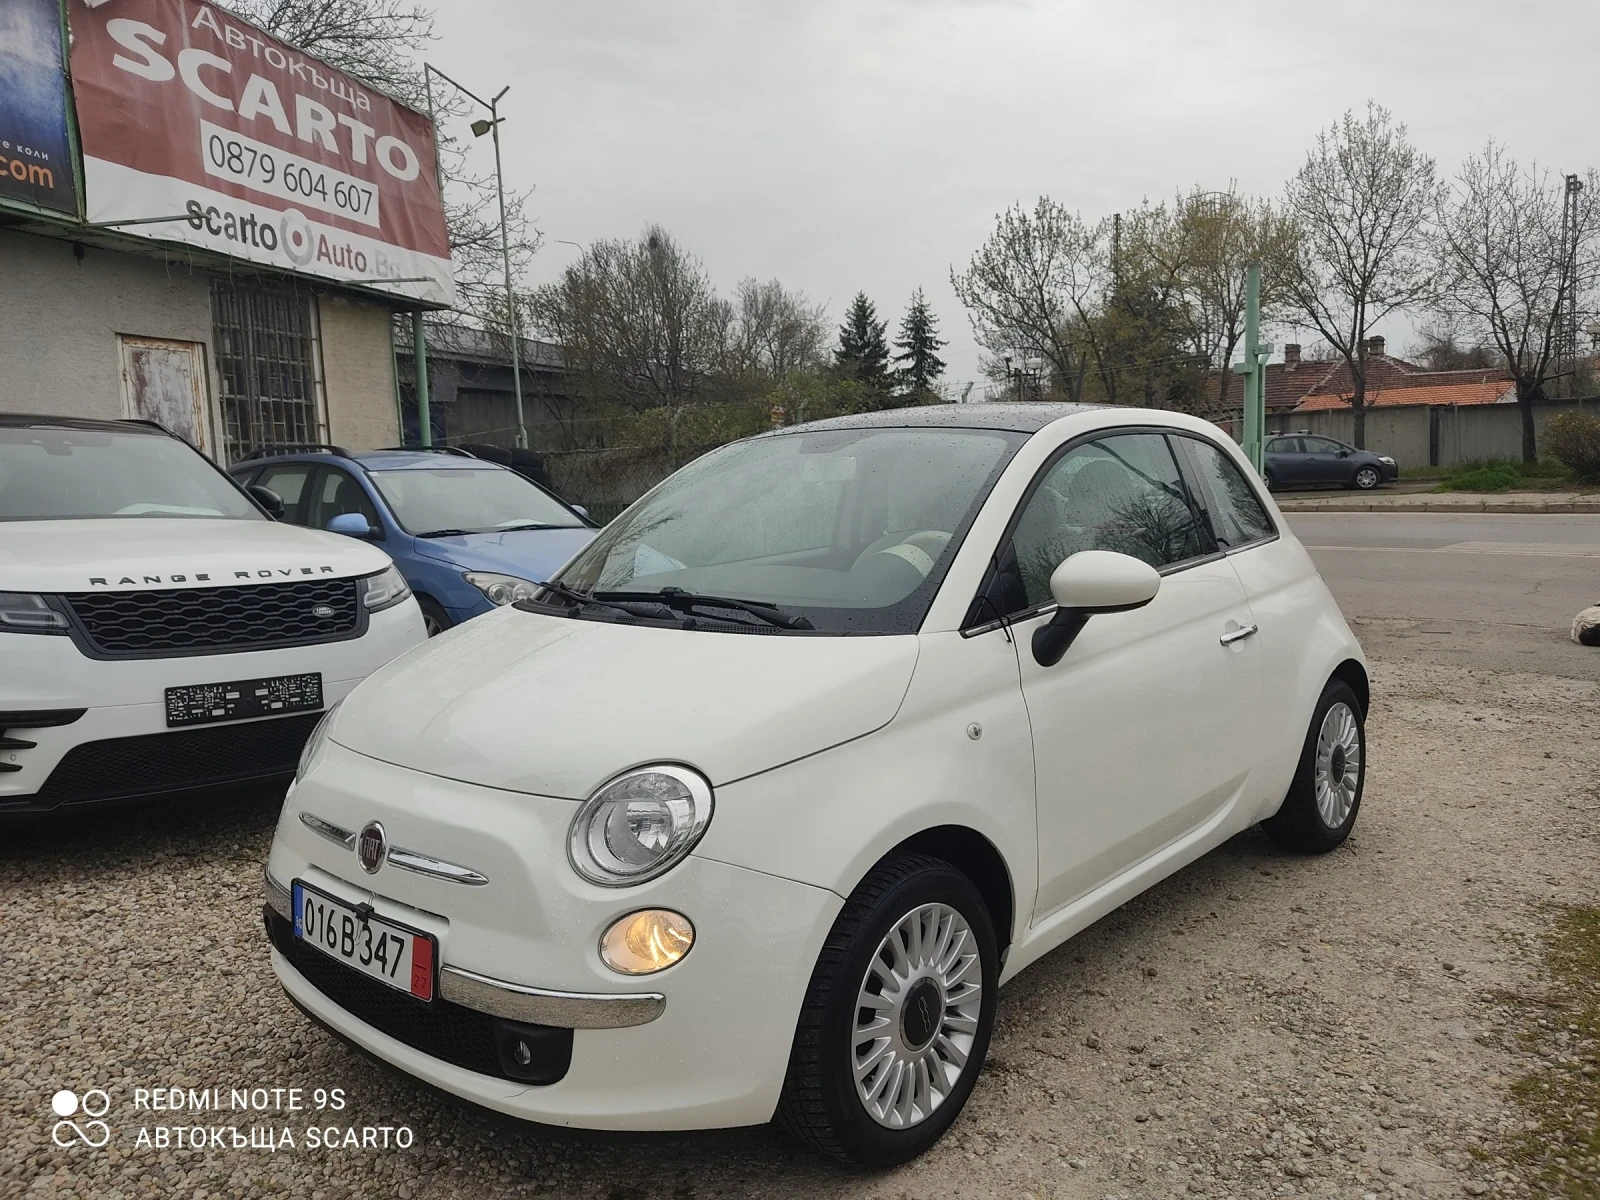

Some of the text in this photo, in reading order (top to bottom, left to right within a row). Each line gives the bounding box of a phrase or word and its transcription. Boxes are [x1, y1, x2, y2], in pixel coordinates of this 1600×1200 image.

[192, 6, 371, 112] Автокъща
[106, 18, 420, 182] SCARTO
[16, 144, 49, 161] коли
[208, 134, 373, 216] 0879 604 607
[186, 199, 278, 251] scarto
[89, 565, 335, 586] RANGE ROVER
[363, 835, 380, 861] FIAT
